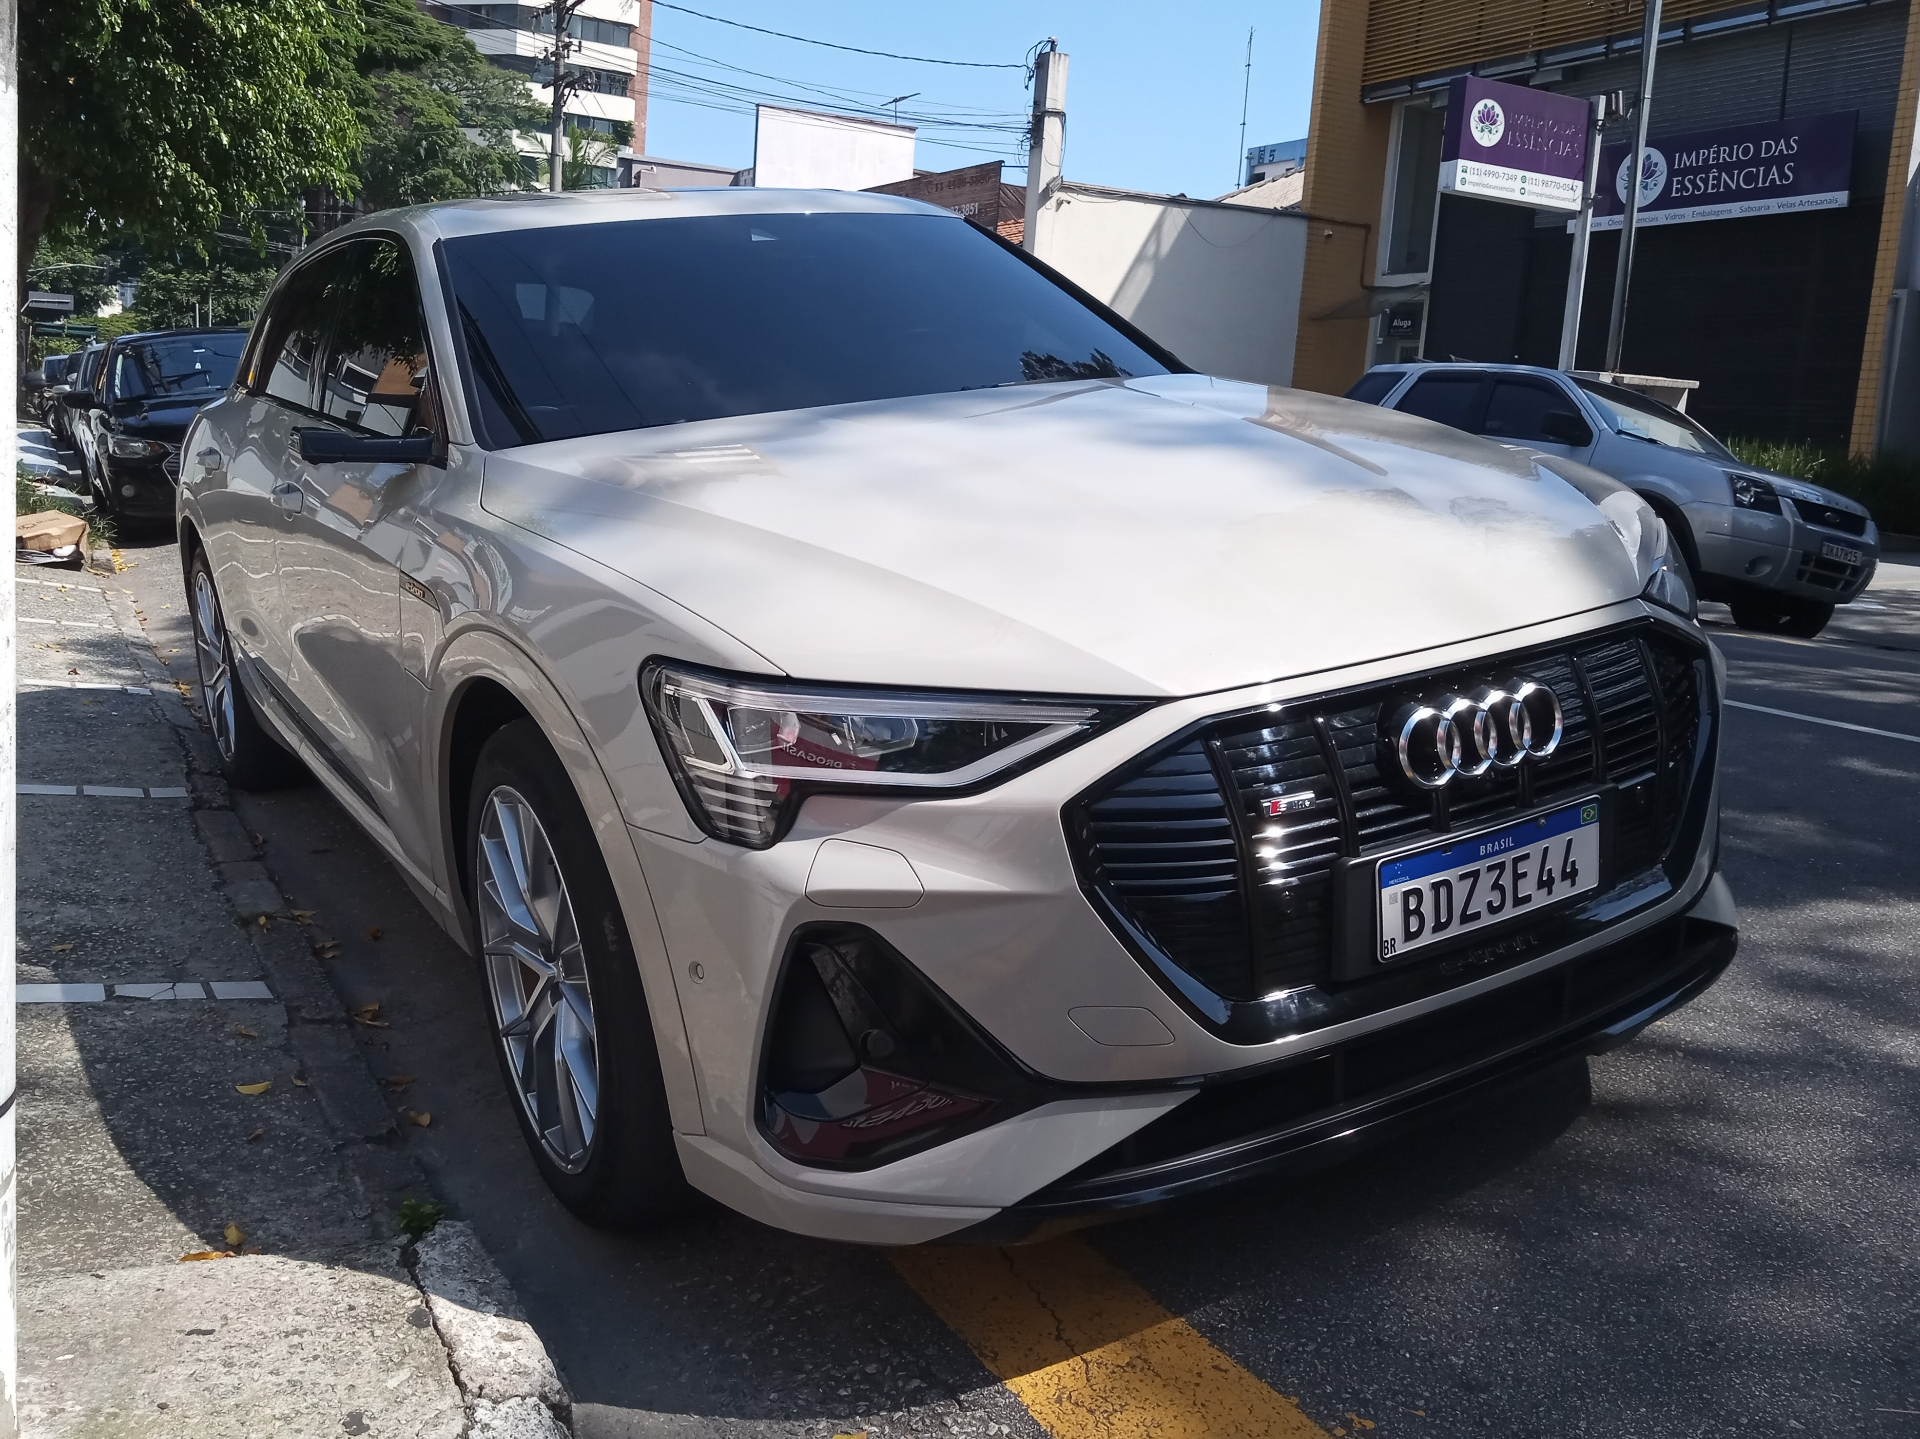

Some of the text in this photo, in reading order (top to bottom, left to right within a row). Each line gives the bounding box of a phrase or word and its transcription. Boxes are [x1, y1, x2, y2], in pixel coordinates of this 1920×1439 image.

[1674, 136, 1799, 169] IMPÉRIO DAS
[1469, 166, 1518, 182] (11) 4990-7349
[1528, 176, 1540, 188] (11)
[1671, 162, 1795, 197] ESSÊNCIAS
[1607, 217, 1623, 227] Óleo
[1664, 213, 1686, 221] Vidros
[1691, 207, 1733, 219] Embalagens
[1739, 203, 1770, 214] Saboaria
[1776, 201, 1797, 210] Velas
[1798, 196, 1839, 208] Artesanais
[1392, 318, 1412, 329] Aluga
[1479, 836, 1515, 856] BRASIL
[1401, 836, 1579, 944] BDZ3E44
[1383, 937, 1397, 957] BR
